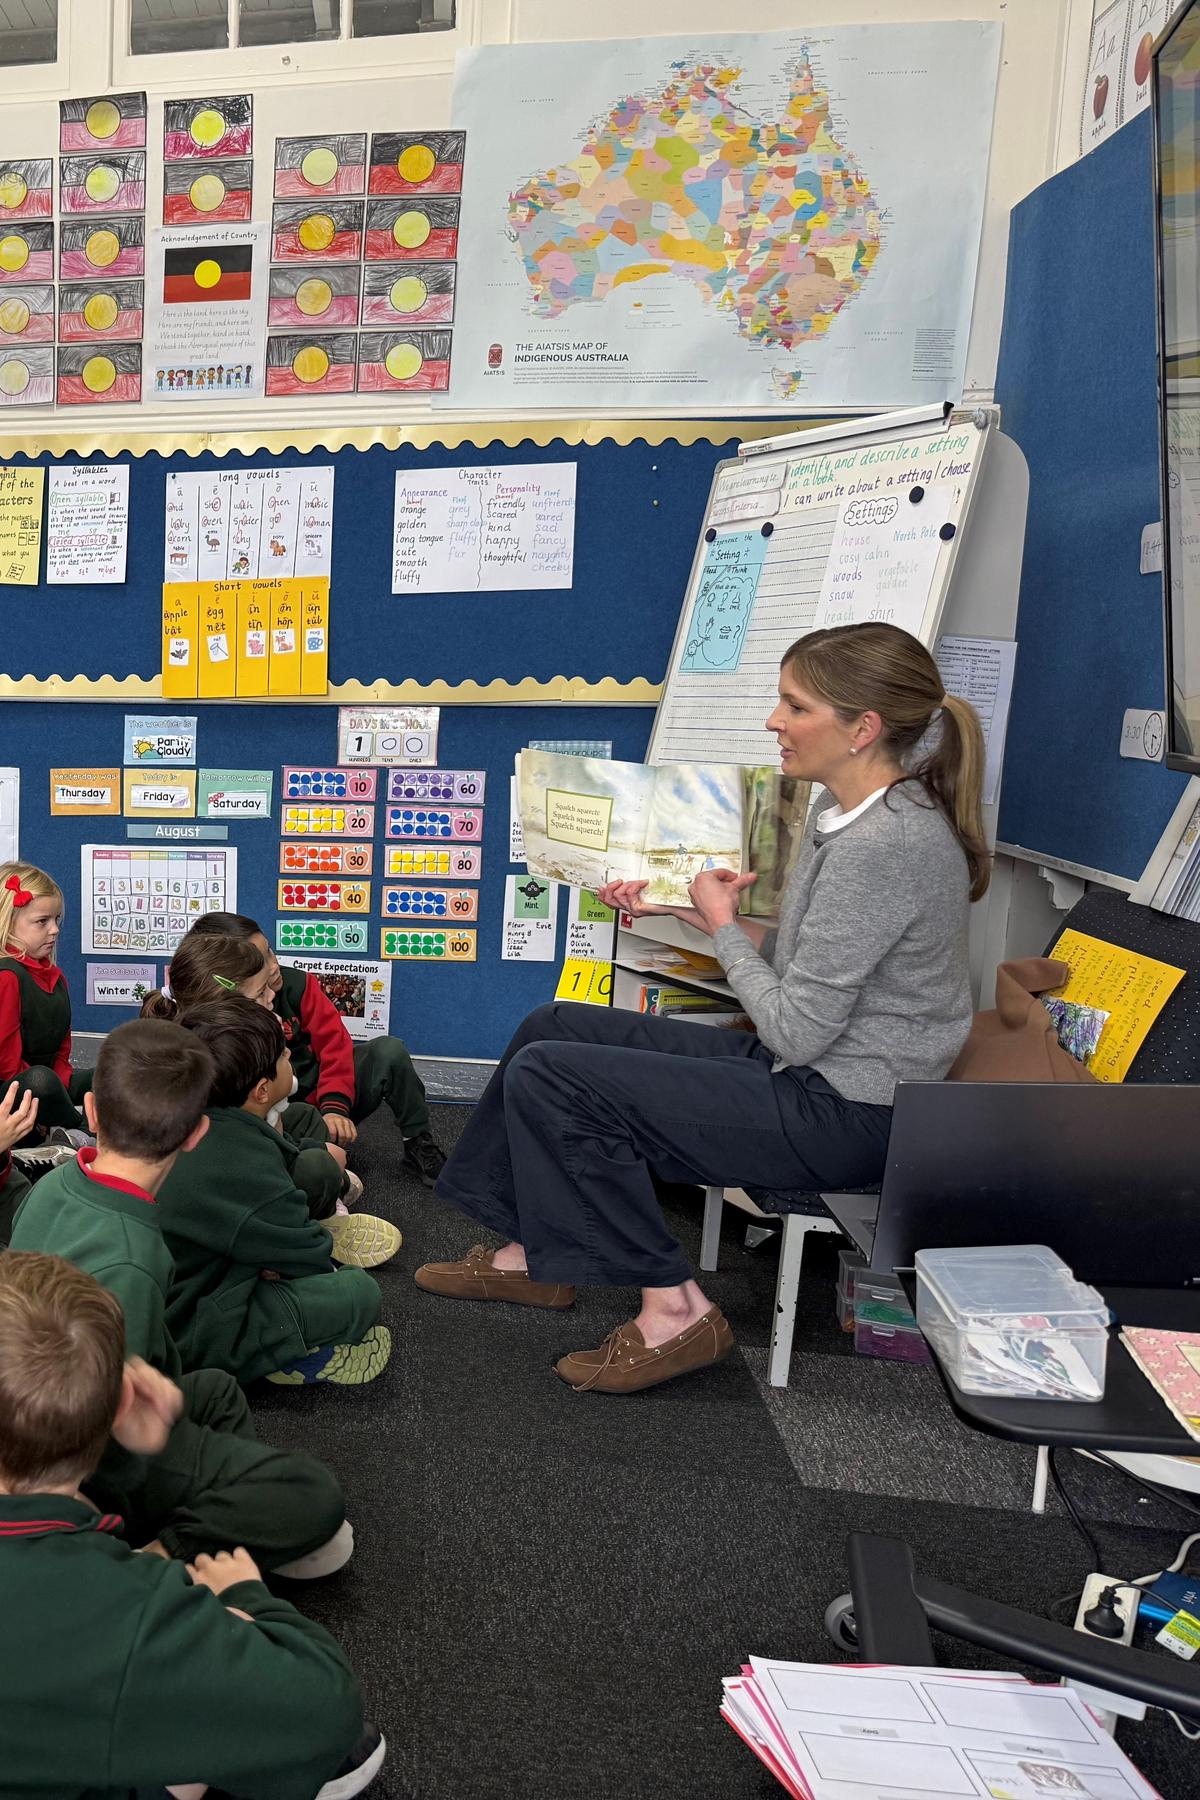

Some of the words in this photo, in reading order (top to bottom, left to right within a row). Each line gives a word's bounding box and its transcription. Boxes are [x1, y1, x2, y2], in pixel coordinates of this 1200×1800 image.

[161, 233, 219, 243] Acknowledgement
[231, 232, 258, 240] Country
[516, 343, 533, 351] THE
[535, 343, 570, 351] AIATSIS
[573, 342, 594, 350] MAP
[595, 342, 608, 350] OF
[514, 354, 573, 363] INDIGENOUS
[575, 354, 629, 362] AUSTRALIA
[790, 455, 830, 478] identify
[834, 452, 858, 469] and
[860, 441, 908, 466] describe
[910, 447, 918, 458] a
[925, 434, 970, 455] setting
[72, 467, 108, 476] Syllables
[219, 473, 239, 484] long
[247, 470, 280, 479] vowels
[459, 469, 502, 480] Character
[7, 480, 16, 491] of
[20, 480, 34, 488] the
[497, 484, 541, 495] Personality
[789, 479, 798, 490] in
[803, 479, 810, 487] a
[795, 494, 812, 505] can
[817, 485, 844, 502] write
[849, 479, 880, 495] about
[887, 476, 893, 485] a
[897, 469, 931, 485] setting
[400, 488, 448, 497] Appearance
[400, 507, 427, 518] orange
[486, 499, 525, 515] friendly
[0, 514, 9, 522] the
[487, 510, 517, 519] scared
[848, 503, 894, 523] Settings
[397, 520, 426, 533] golden
[488, 523, 511, 532] kind
[893, 527, 916, 542] North
[921, 525, 936, 539] Pole
[396, 535, 415, 547] long
[419, 535, 444, 547] tongue
[485, 535, 520, 549] happy
[20, 551, 30, 559] you
[396, 548, 417, 556] cute
[715, 550, 741, 563] Setting
[395, 558, 427, 567] smooth
[484, 552, 527, 565] thoughtful
[394, 569, 421, 585] fluffy
[833, 567, 862, 582] woods
[253, 581, 282, 589] vowels
[829, 590, 854, 601] snow
[157, 746, 191, 757] Cloudy
[355, 783, 366, 792] 10
[460, 784, 476, 794] 60
[60, 788, 105, 799] Thursday
[143, 792, 175, 803] Friday
[213, 799, 261, 809] Saturday
[351, 819, 366, 829] 20
[459, 822, 473, 832] 70
[551, 819, 574, 830] Squelch
[576, 826, 604, 836] squerch!
[155, 825, 200, 838] August
[350, 855, 364, 866] 30
[457, 859, 472, 870] 80
[347, 894, 362, 904] 40
[454, 901, 469, 912] 90
[587, 910, 605, 918] Green
[345, 932, 360, 944] 50
[451, 941, 469, 952] 100
[293, 960, 322, 971] Carpet
[324, 962, 378, 974] Expectations
[97, 986, 131, 996] Winter
